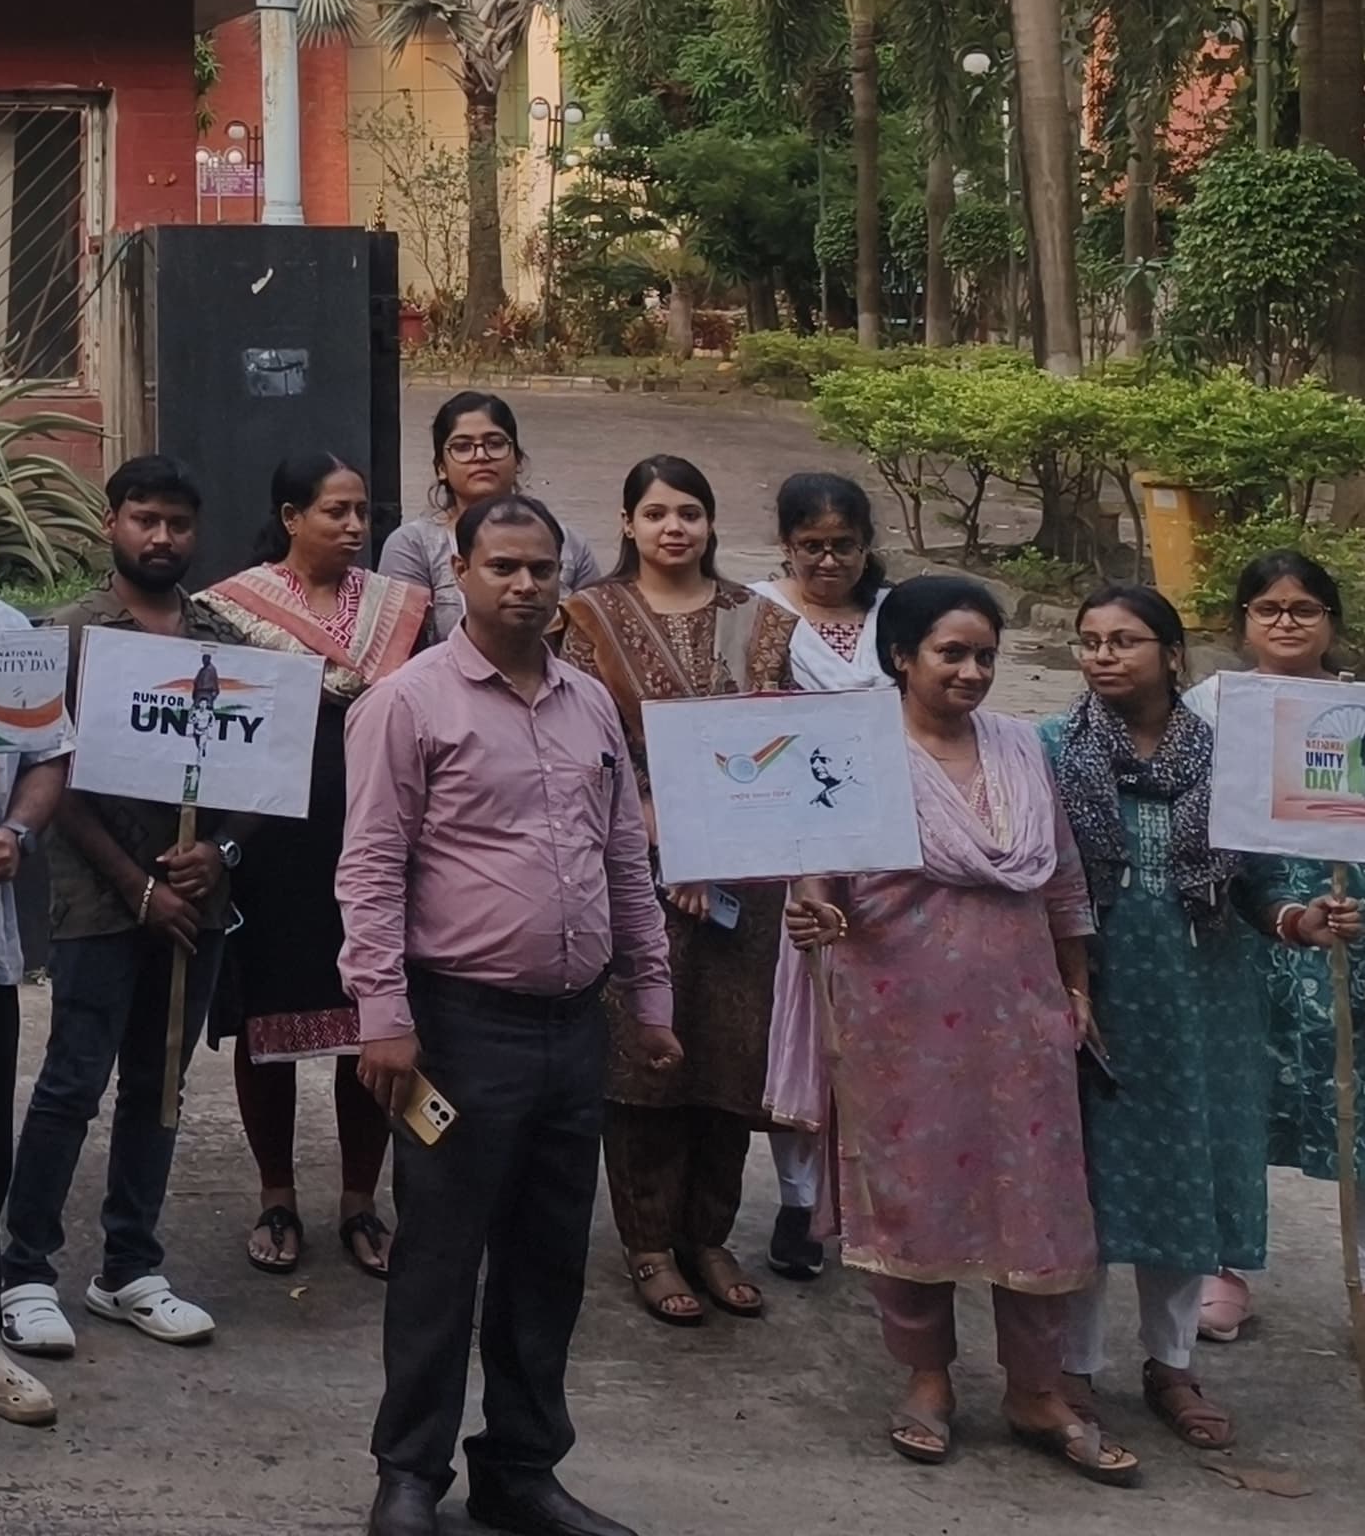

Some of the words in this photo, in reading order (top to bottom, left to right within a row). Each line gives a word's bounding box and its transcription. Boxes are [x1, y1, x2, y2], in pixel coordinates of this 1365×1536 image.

[30, 656, 58, 672] DAY
[132, 691, 158, 705] RUN
[160, 694, 185, 707] FOR
[131, 703, 265, 744] UNTY
[1305, 751, 1345, 769] UNITY
[1305, 767, 1344, 793] DAY
